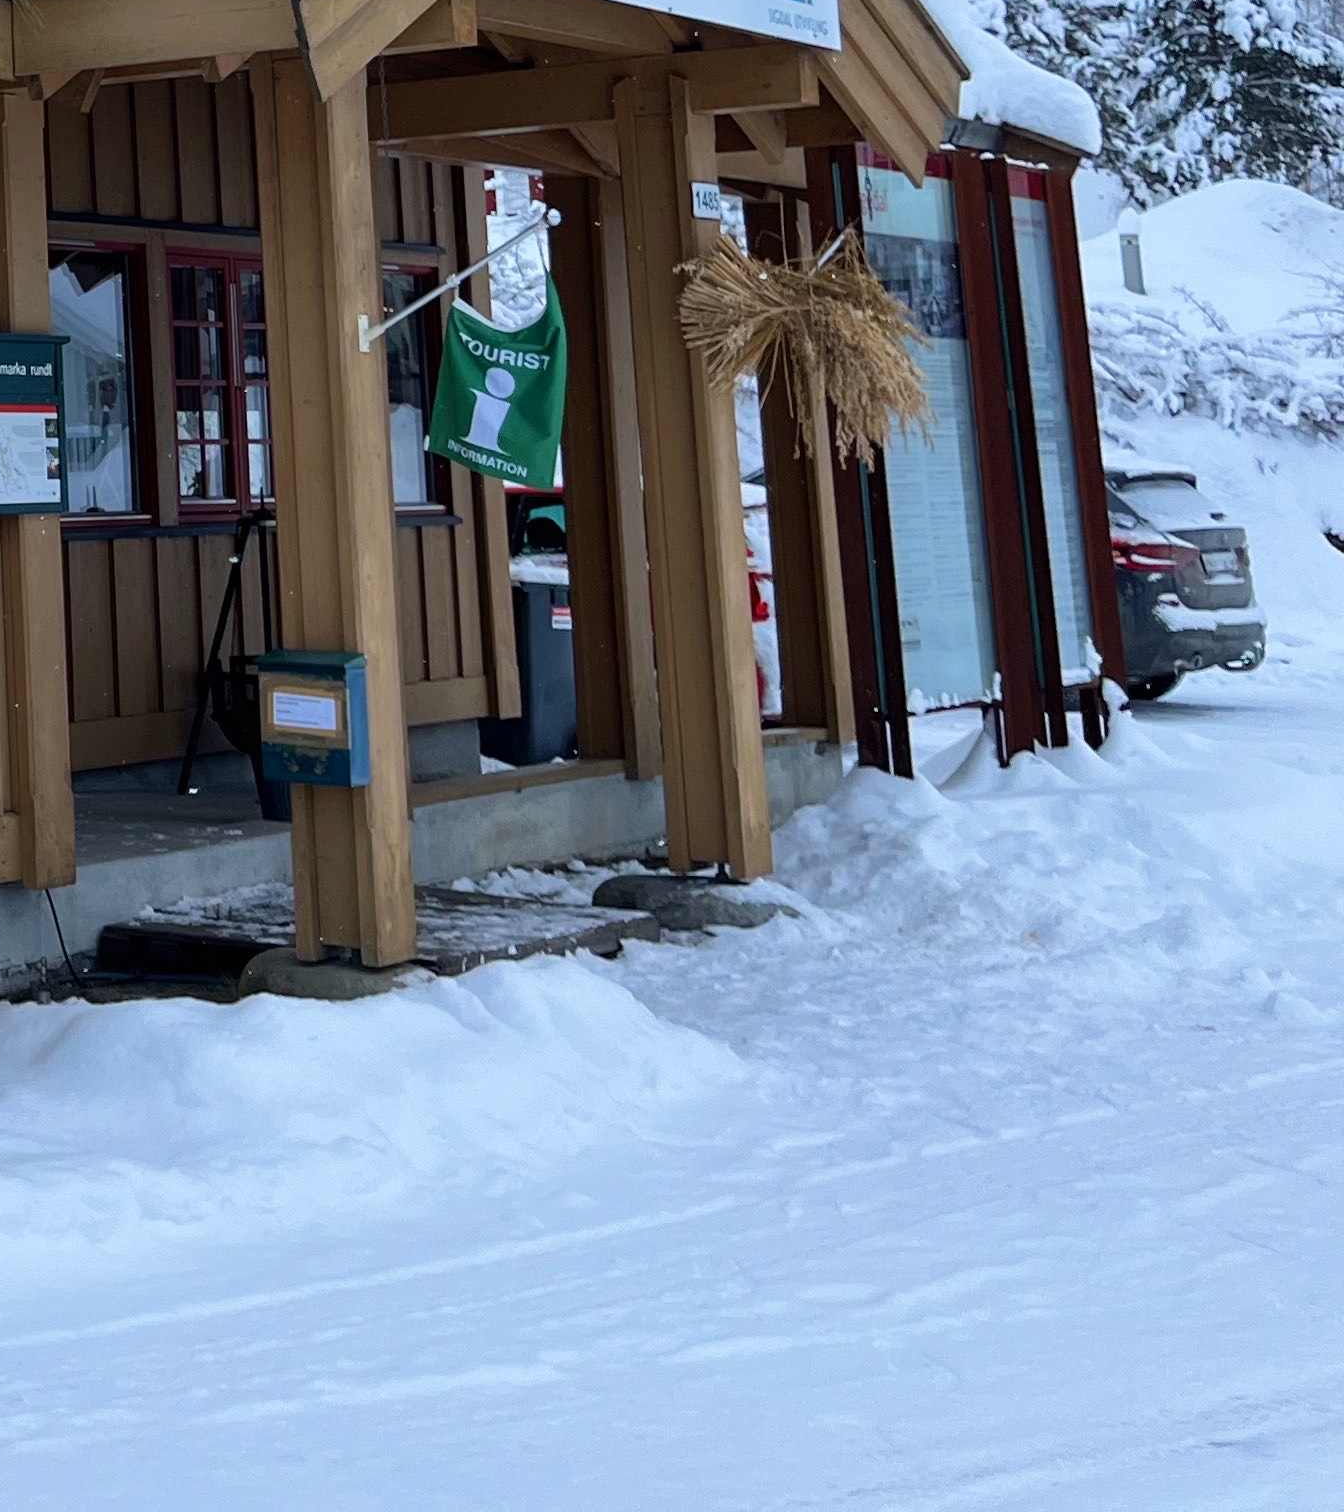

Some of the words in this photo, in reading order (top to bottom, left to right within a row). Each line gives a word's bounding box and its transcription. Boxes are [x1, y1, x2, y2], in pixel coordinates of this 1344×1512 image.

[30, 363, 53, 377] rundt
[459, 331, 550, 370] TOURIST
[447, 438, 528, 478] INFORMATION
